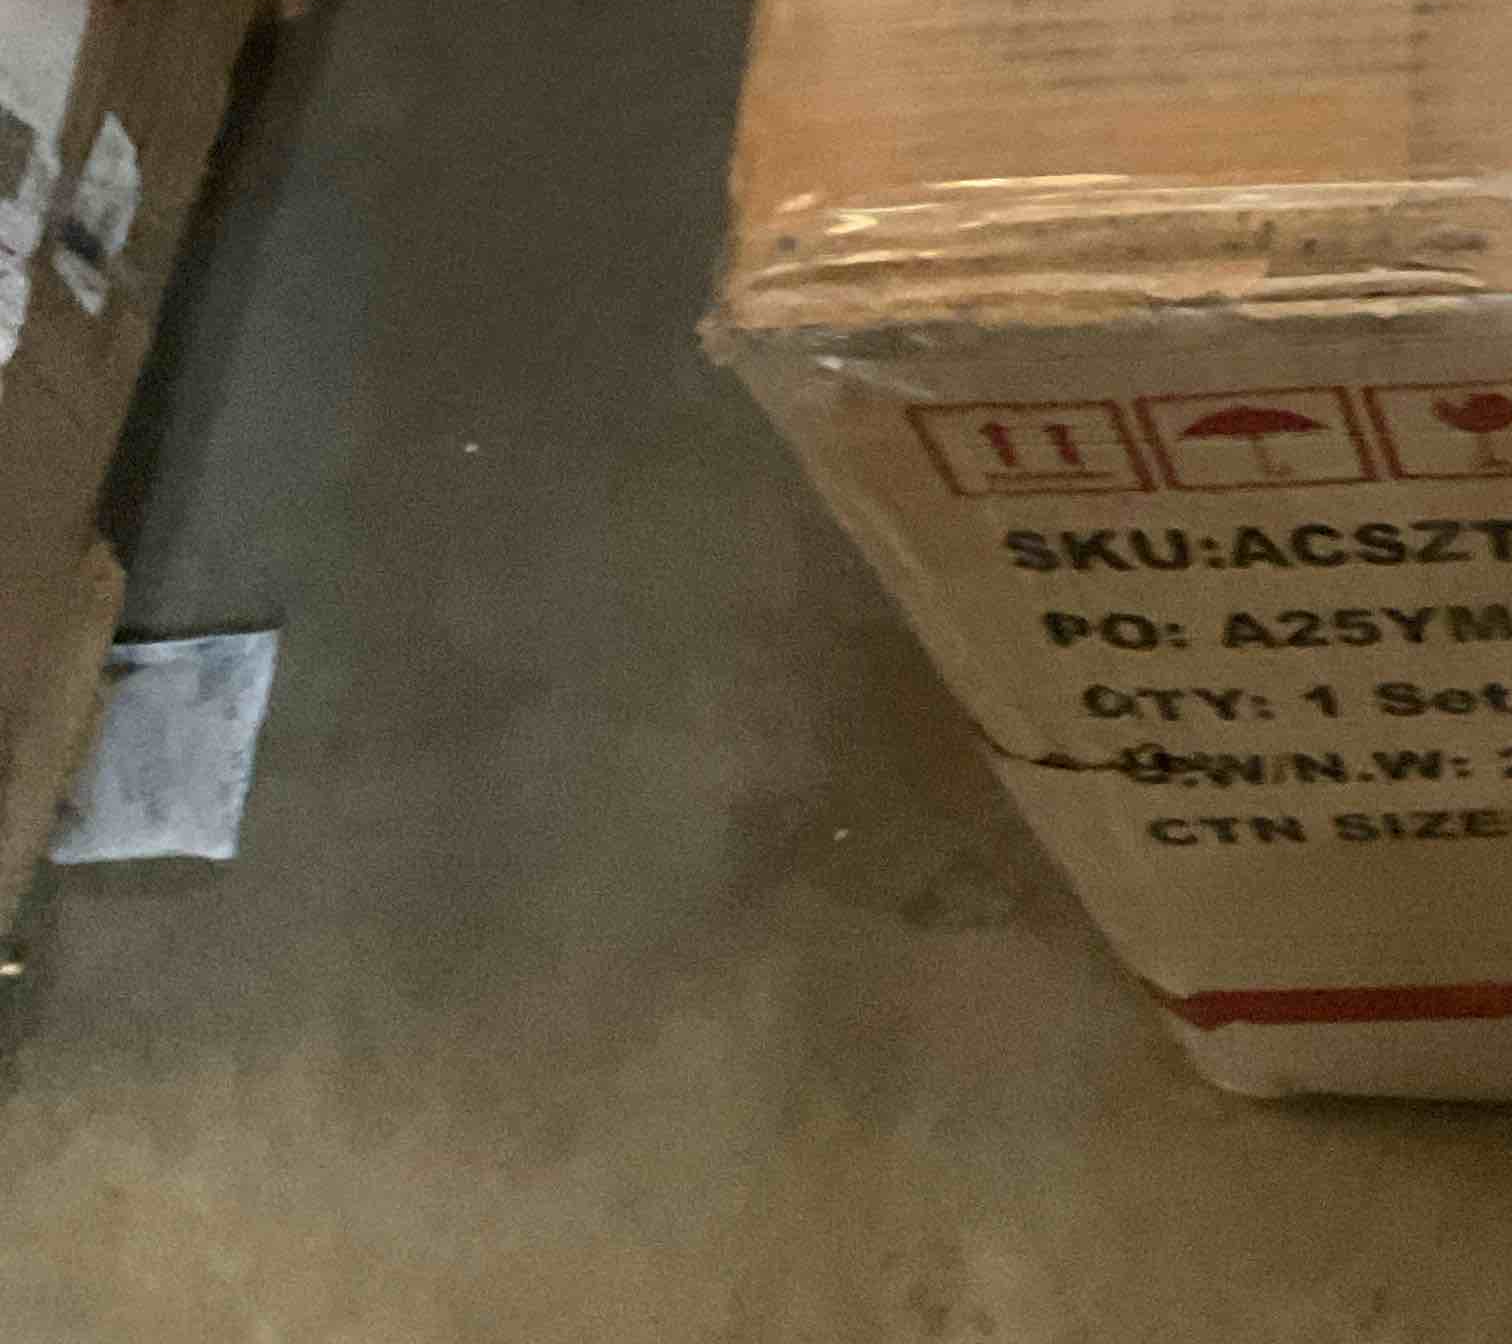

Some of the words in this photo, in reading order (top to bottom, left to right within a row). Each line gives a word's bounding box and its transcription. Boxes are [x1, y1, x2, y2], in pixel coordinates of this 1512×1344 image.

[1040, 608, 1188, 652] PO:
[1081, 681, 1277, 722] QTY:
[1303, 683, 1340, 719] 1
[1148, 814, 1308, 846] CTN
